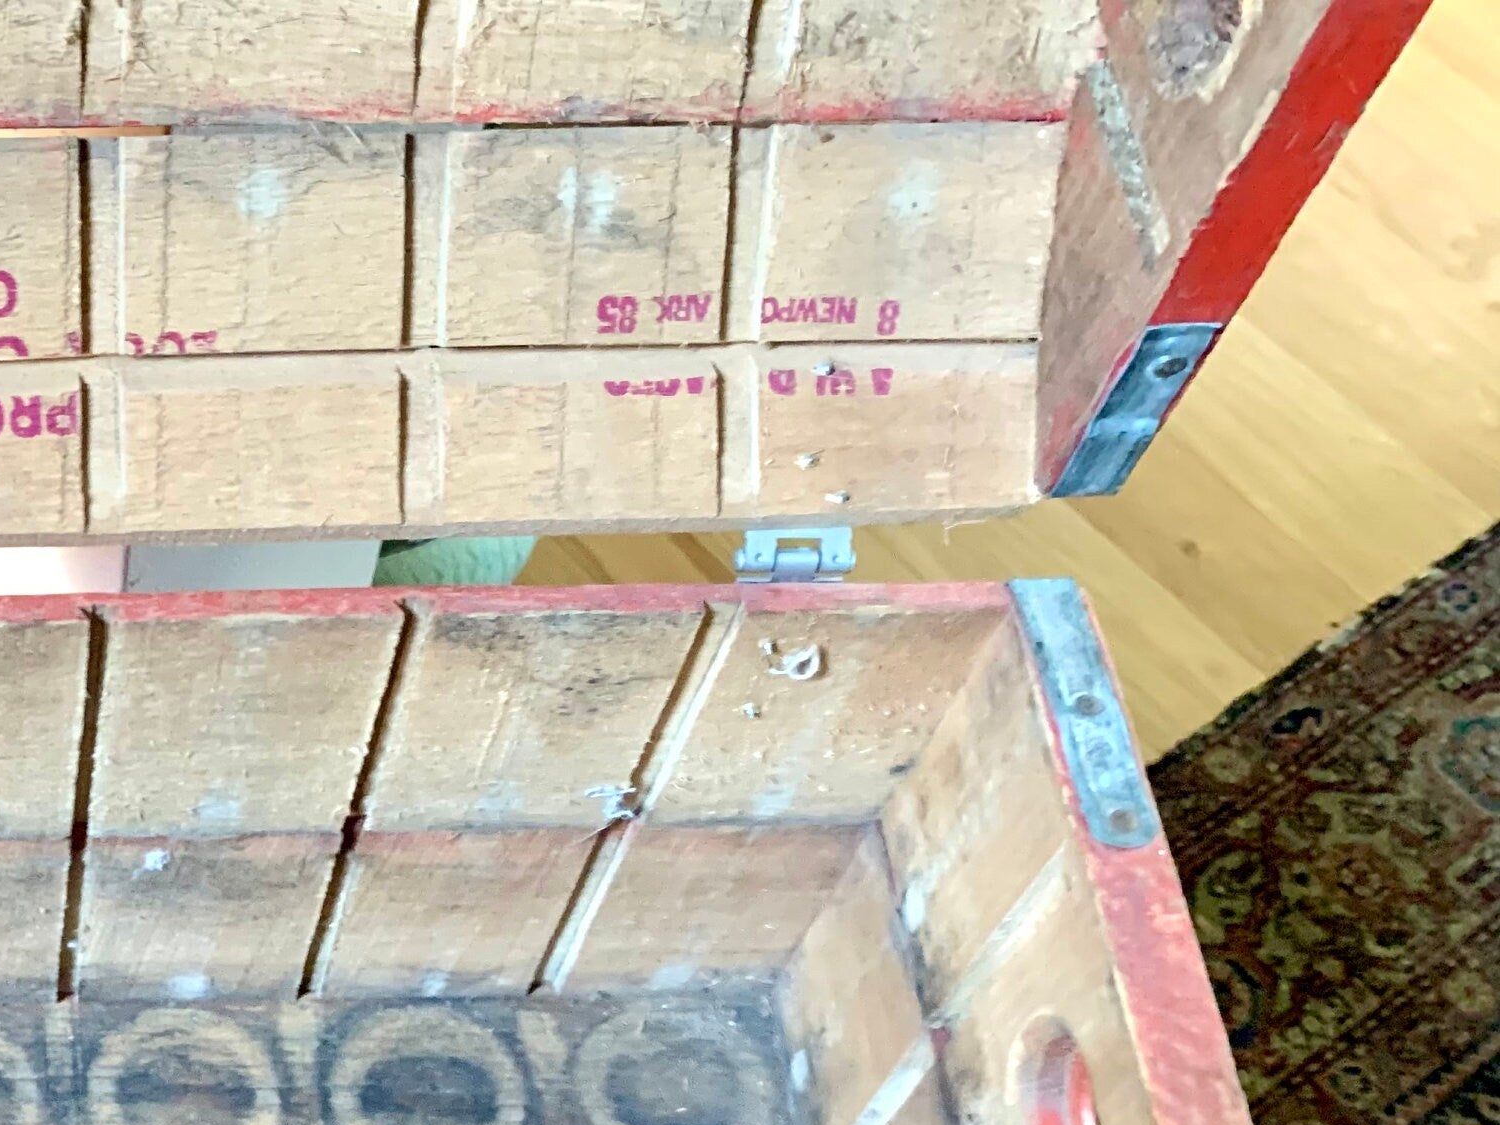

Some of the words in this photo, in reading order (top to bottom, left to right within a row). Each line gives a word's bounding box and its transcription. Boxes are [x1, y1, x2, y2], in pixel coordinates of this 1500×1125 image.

[596, 294, 640, 334] 85
[653, 293, 713, 323] ARK
[760, 294, 858, 325] NEWPO
[876, 299, 900, 335] 8
